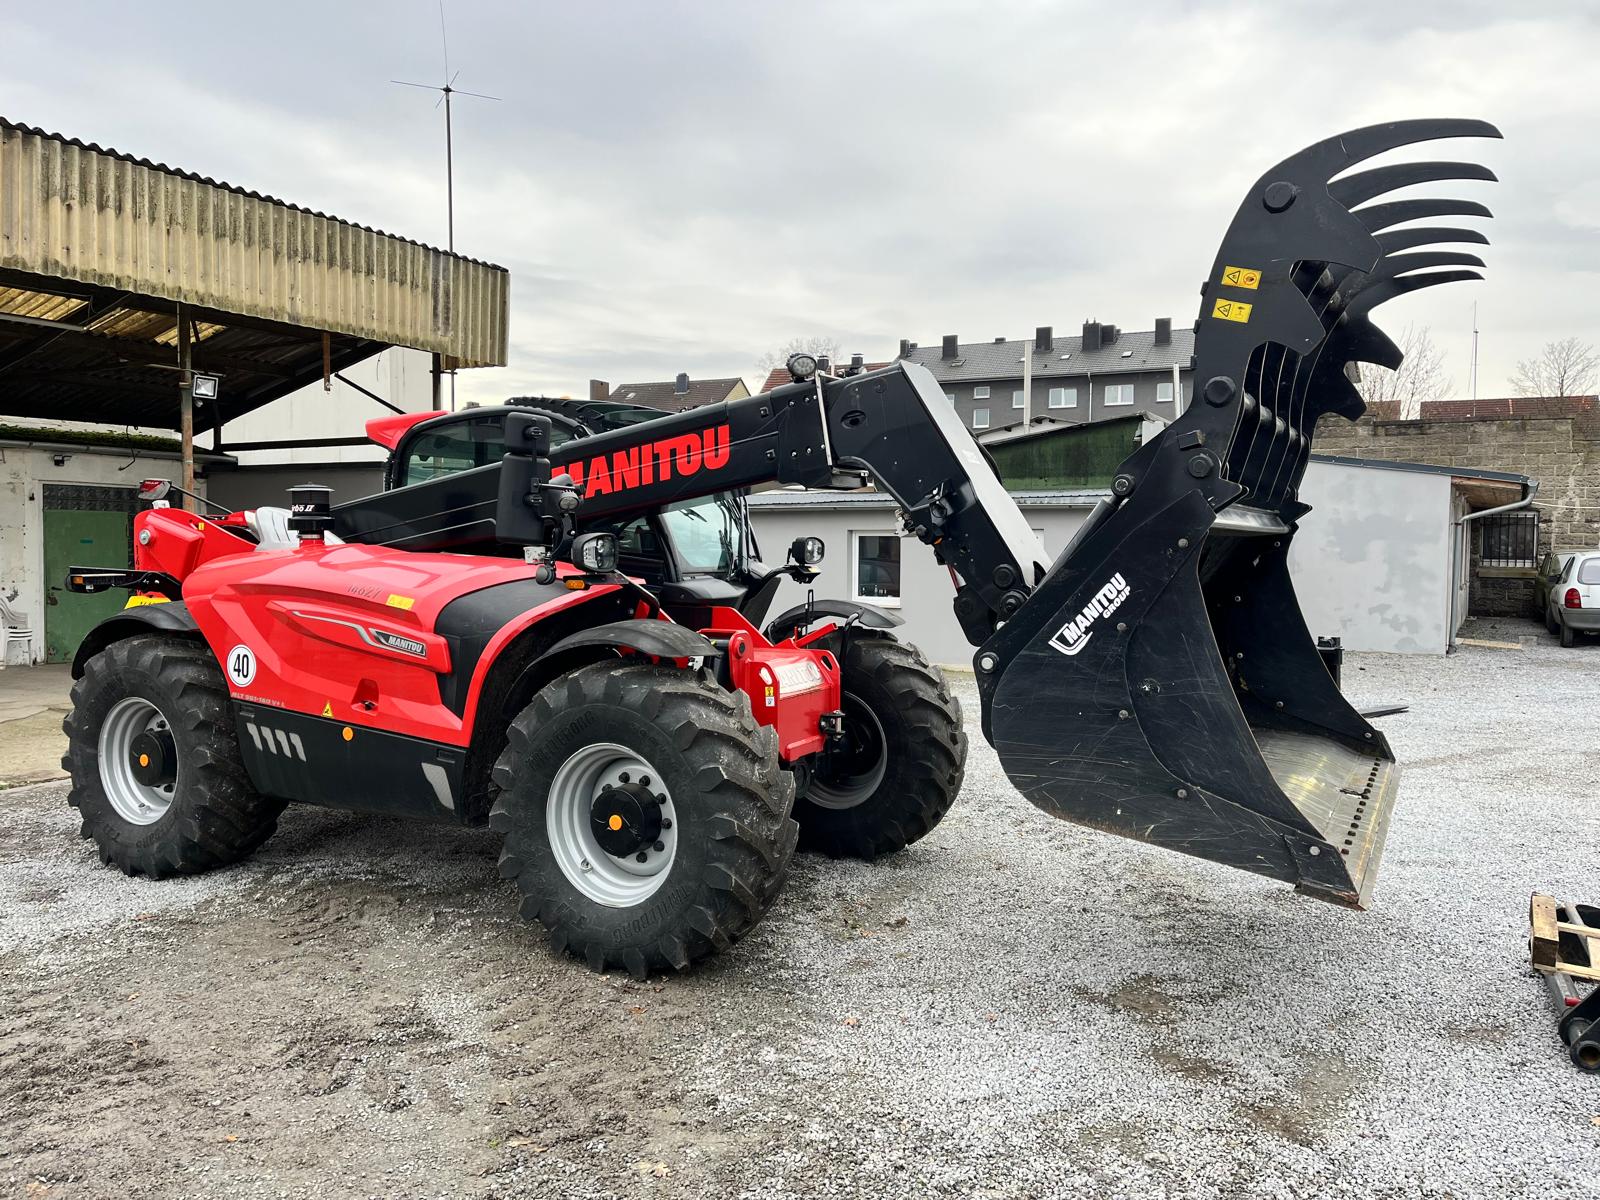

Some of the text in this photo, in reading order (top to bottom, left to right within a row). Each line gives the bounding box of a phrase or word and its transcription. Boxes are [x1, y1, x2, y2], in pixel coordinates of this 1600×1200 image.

[551, 424, 730, 499] MANITOU
[1062, 572, 1126, 645] MANITOU
[1102, 585, 1131, 619] GROUP
[388, 635, 423, 652] MANITOU
[233, 653, 249, 678] 40
